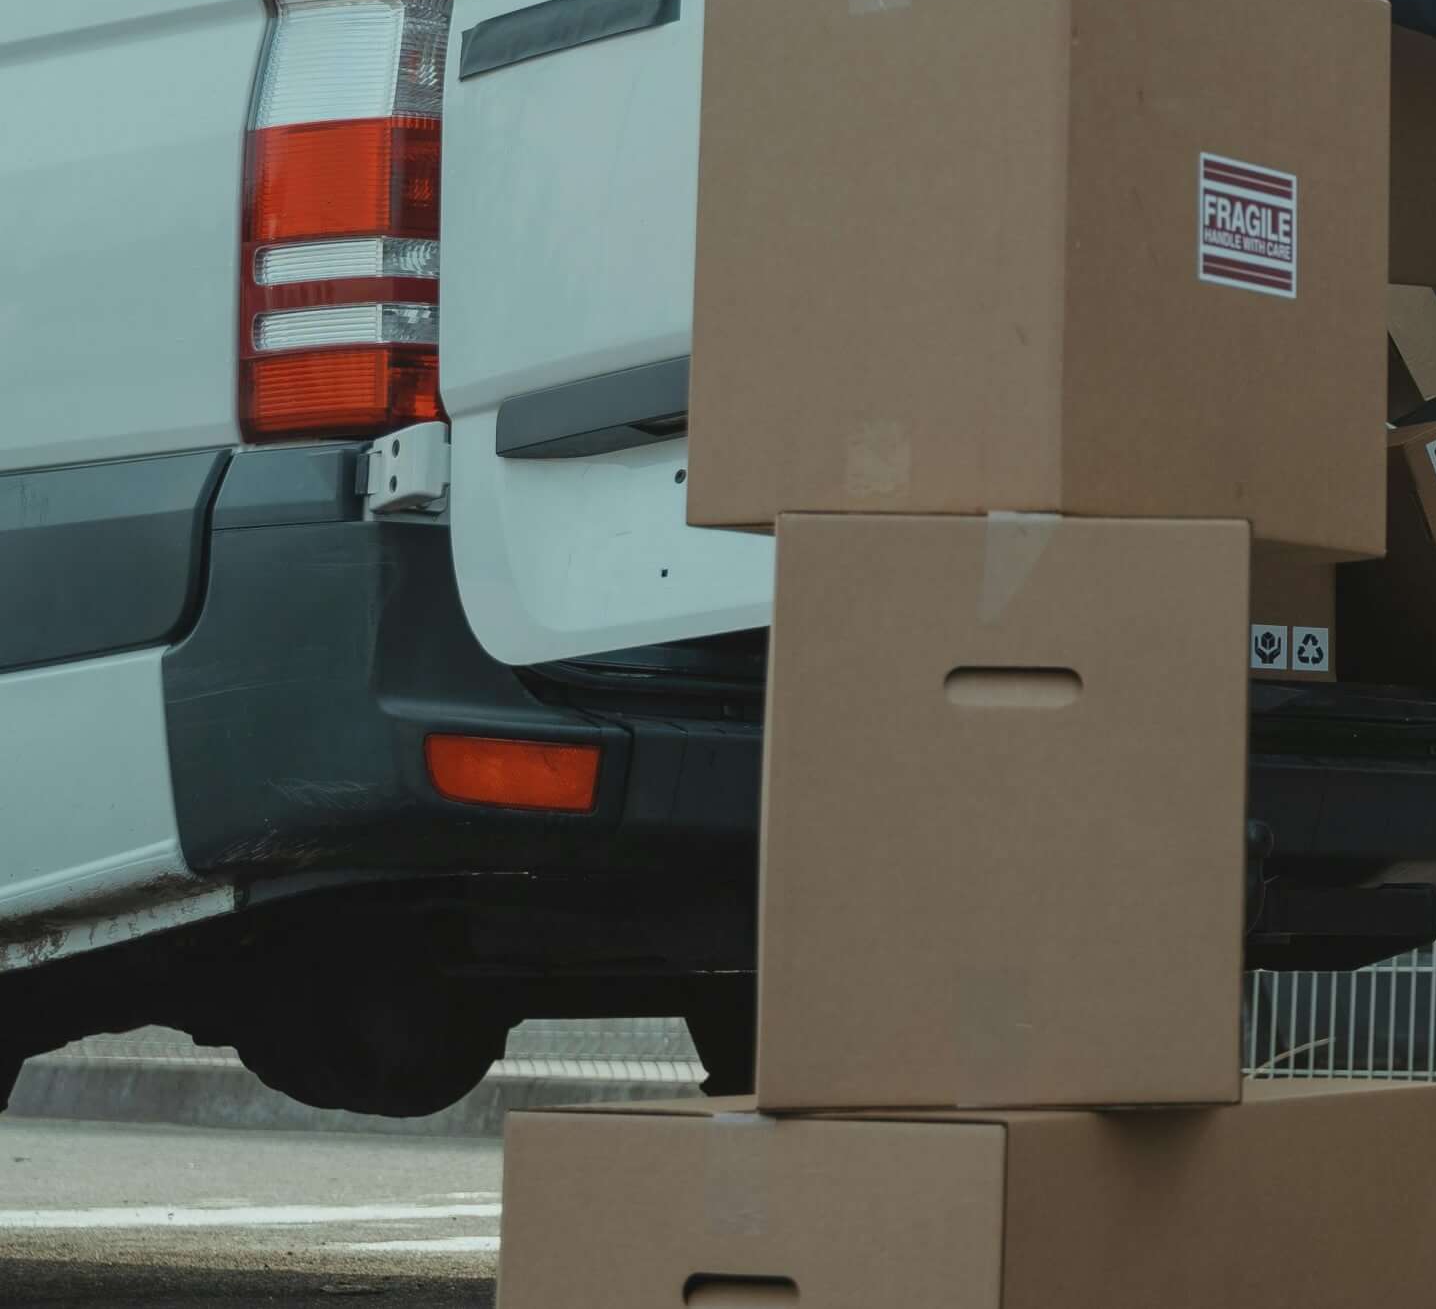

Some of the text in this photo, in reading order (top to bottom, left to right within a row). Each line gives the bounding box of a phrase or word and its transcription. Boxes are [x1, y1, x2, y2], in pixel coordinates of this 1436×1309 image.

[1204, 194, 1291, 242] FRAGILE
[1204, 228, 1291, 261] HANDLE WITH CARE
